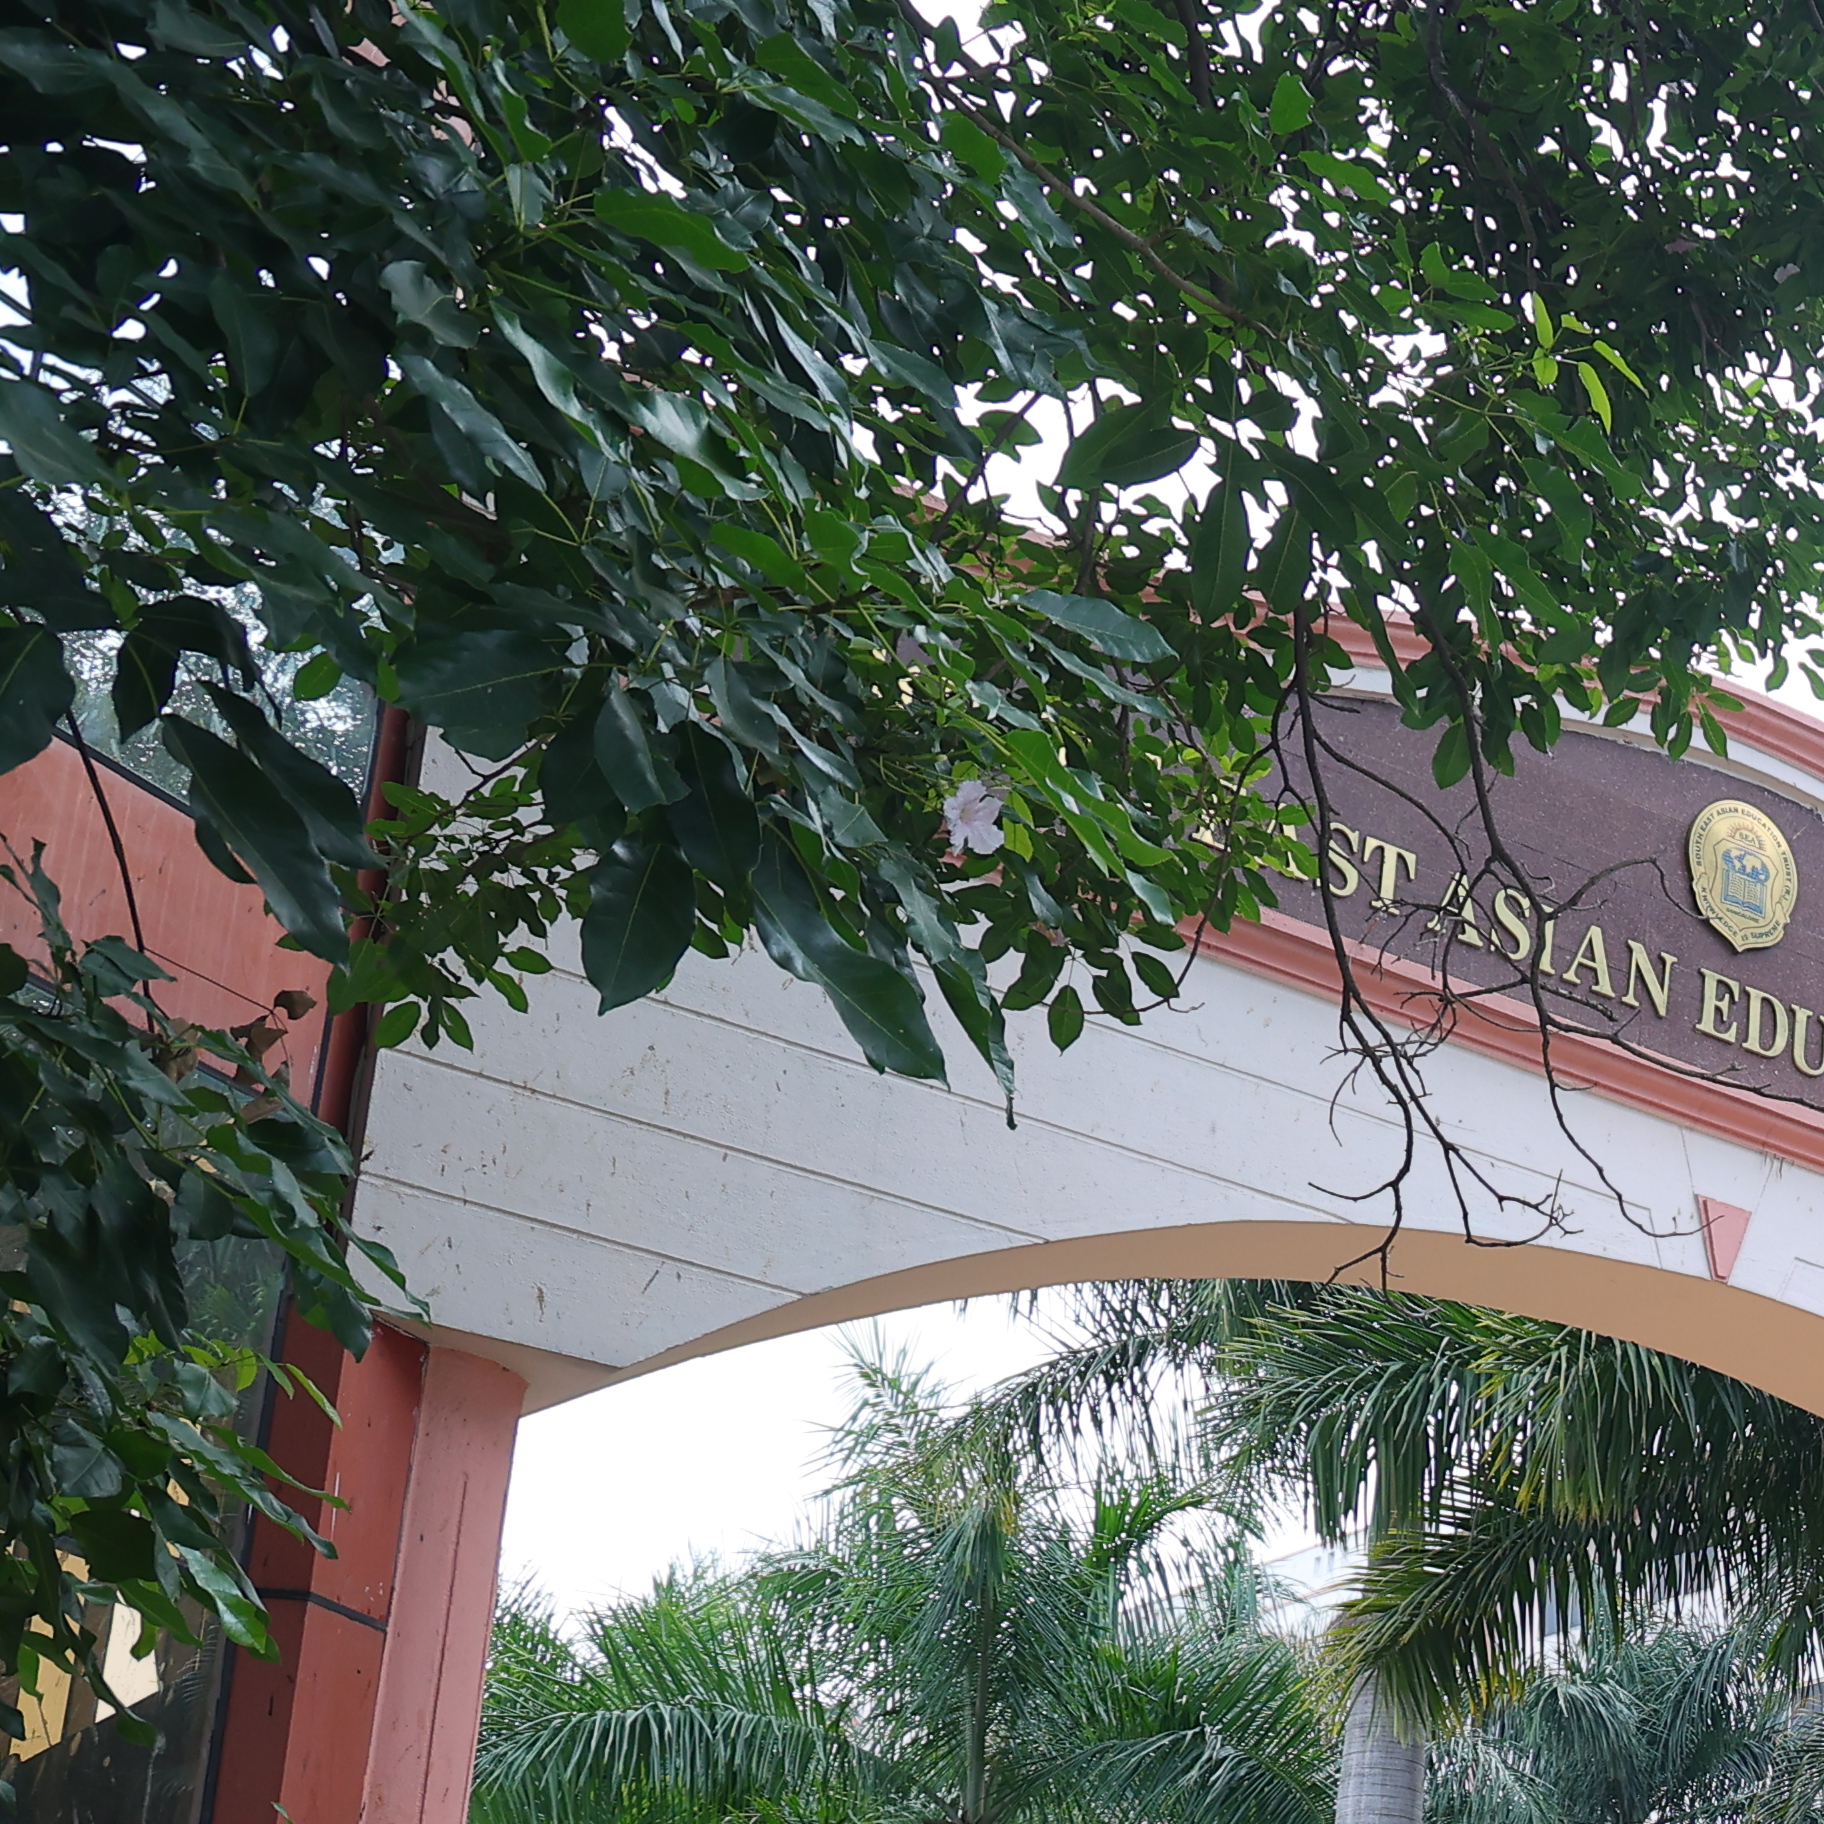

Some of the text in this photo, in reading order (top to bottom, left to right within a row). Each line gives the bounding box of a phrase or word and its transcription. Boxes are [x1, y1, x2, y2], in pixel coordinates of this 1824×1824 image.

[1695, 833, 1705, 867] SOUTH
[1701, 812, 1716, 832] EAST
[1716, 806, 1739, 817] ASIAN
[1741, 808, 1783, 849] EDUCATION
[1780, 850, 1792, 884] TRUST
[1738, 831, 1757, 845] SEA
[1426, 872, 1678, 1019] ASIAN
